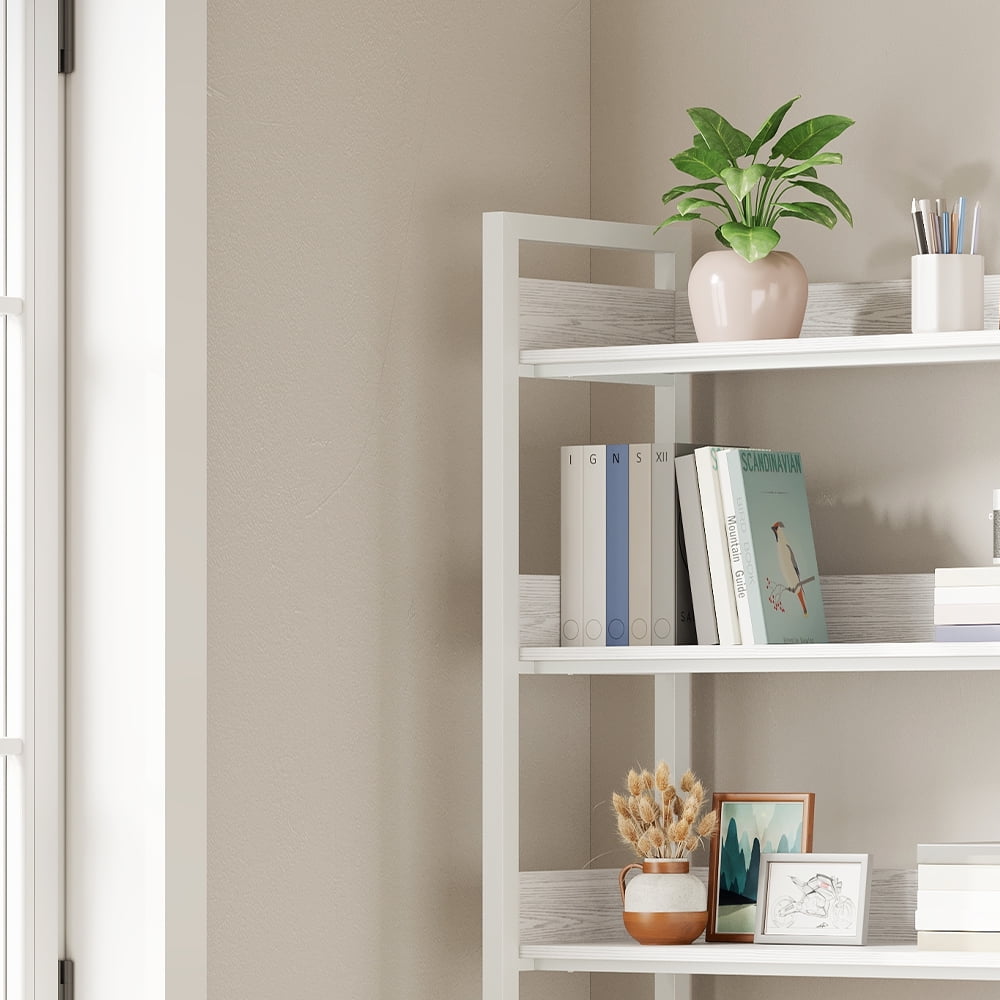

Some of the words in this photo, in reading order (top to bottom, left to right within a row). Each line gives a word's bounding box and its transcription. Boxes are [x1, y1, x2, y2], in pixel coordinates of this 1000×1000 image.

[589, 453, 598, 465] G
[612, 452, 620, 464] N
[635, 451, 642, 463] S
[655, 451, 668, 463] XII
[741, 451, 802, 474] SCANDINAVIAN
[727, 515, 741, 563] Mountain
[735, 570, 747, 600] Guide
